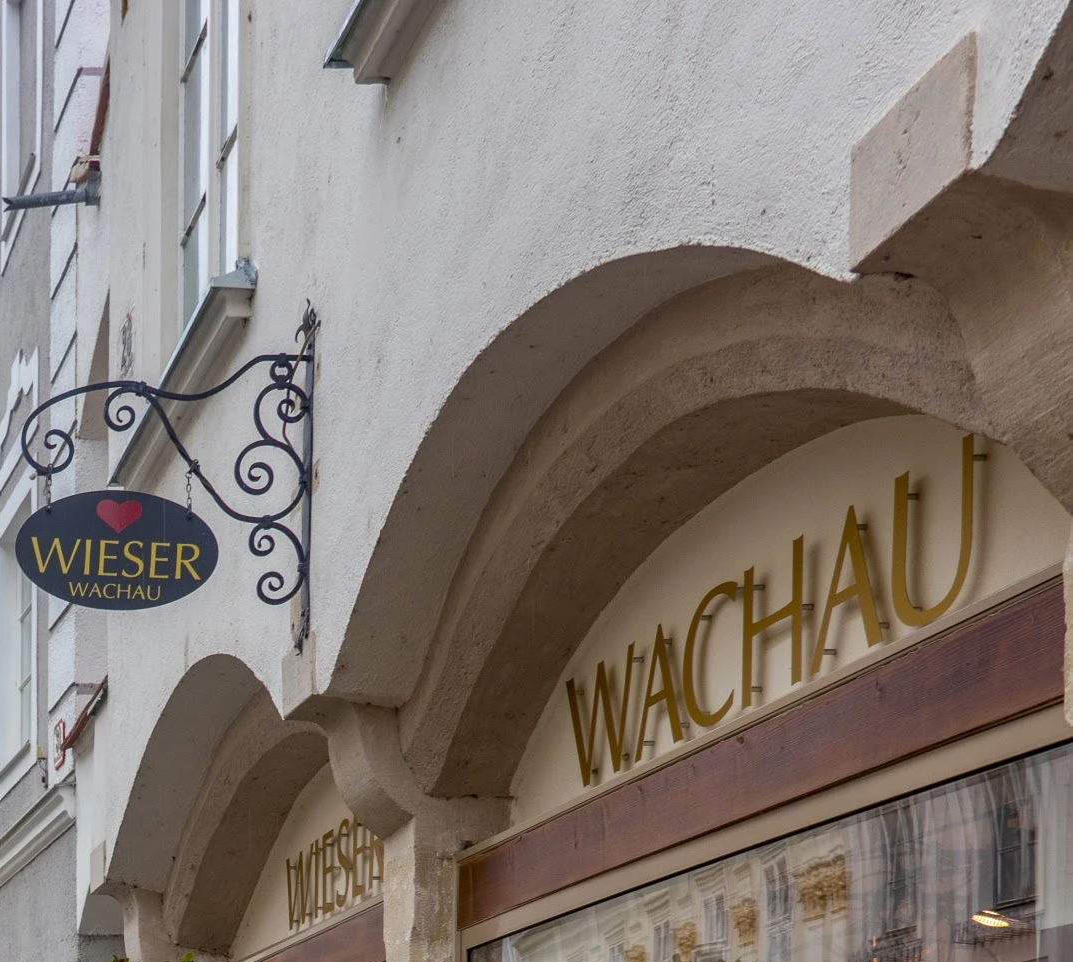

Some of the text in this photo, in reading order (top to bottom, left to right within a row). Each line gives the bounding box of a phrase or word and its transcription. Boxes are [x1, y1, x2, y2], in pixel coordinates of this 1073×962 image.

[31, 536, 201, 581] WIESER
[68, 581, 161, 601] WACHAU
[566, 432, 974, 789] WACHAU
